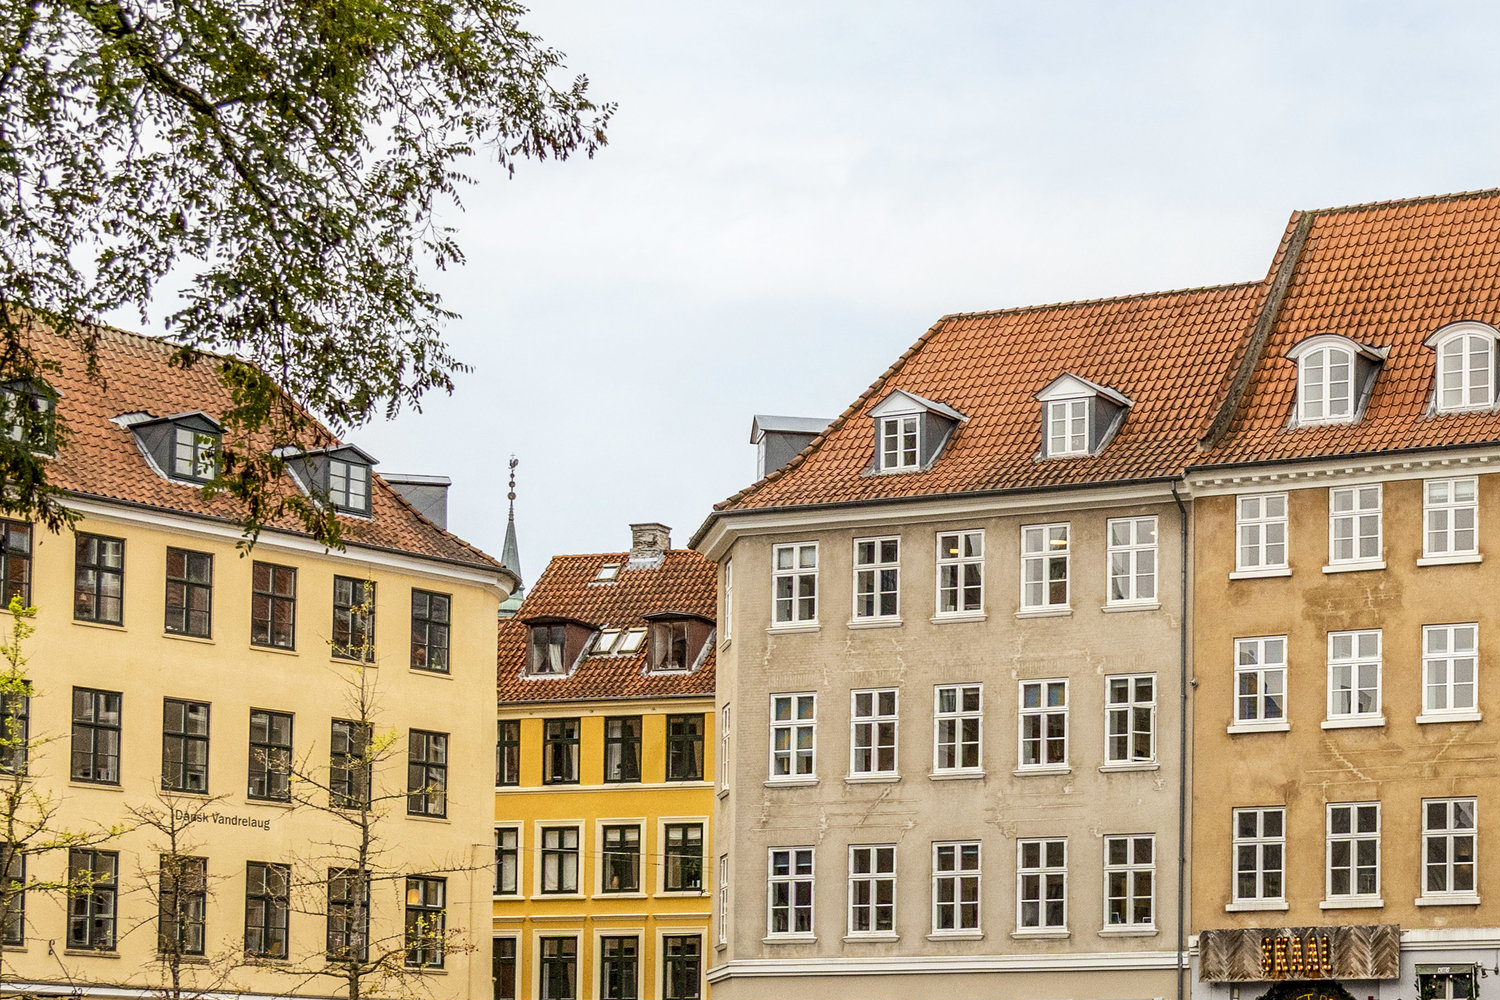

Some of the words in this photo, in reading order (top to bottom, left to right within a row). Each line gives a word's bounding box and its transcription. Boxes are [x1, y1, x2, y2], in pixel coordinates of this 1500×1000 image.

[175, 810, 209, 823] Dansk
[212, 813, 271, 831] Vandrelaug
[1261, 936, 1333, 972] SKAAL
